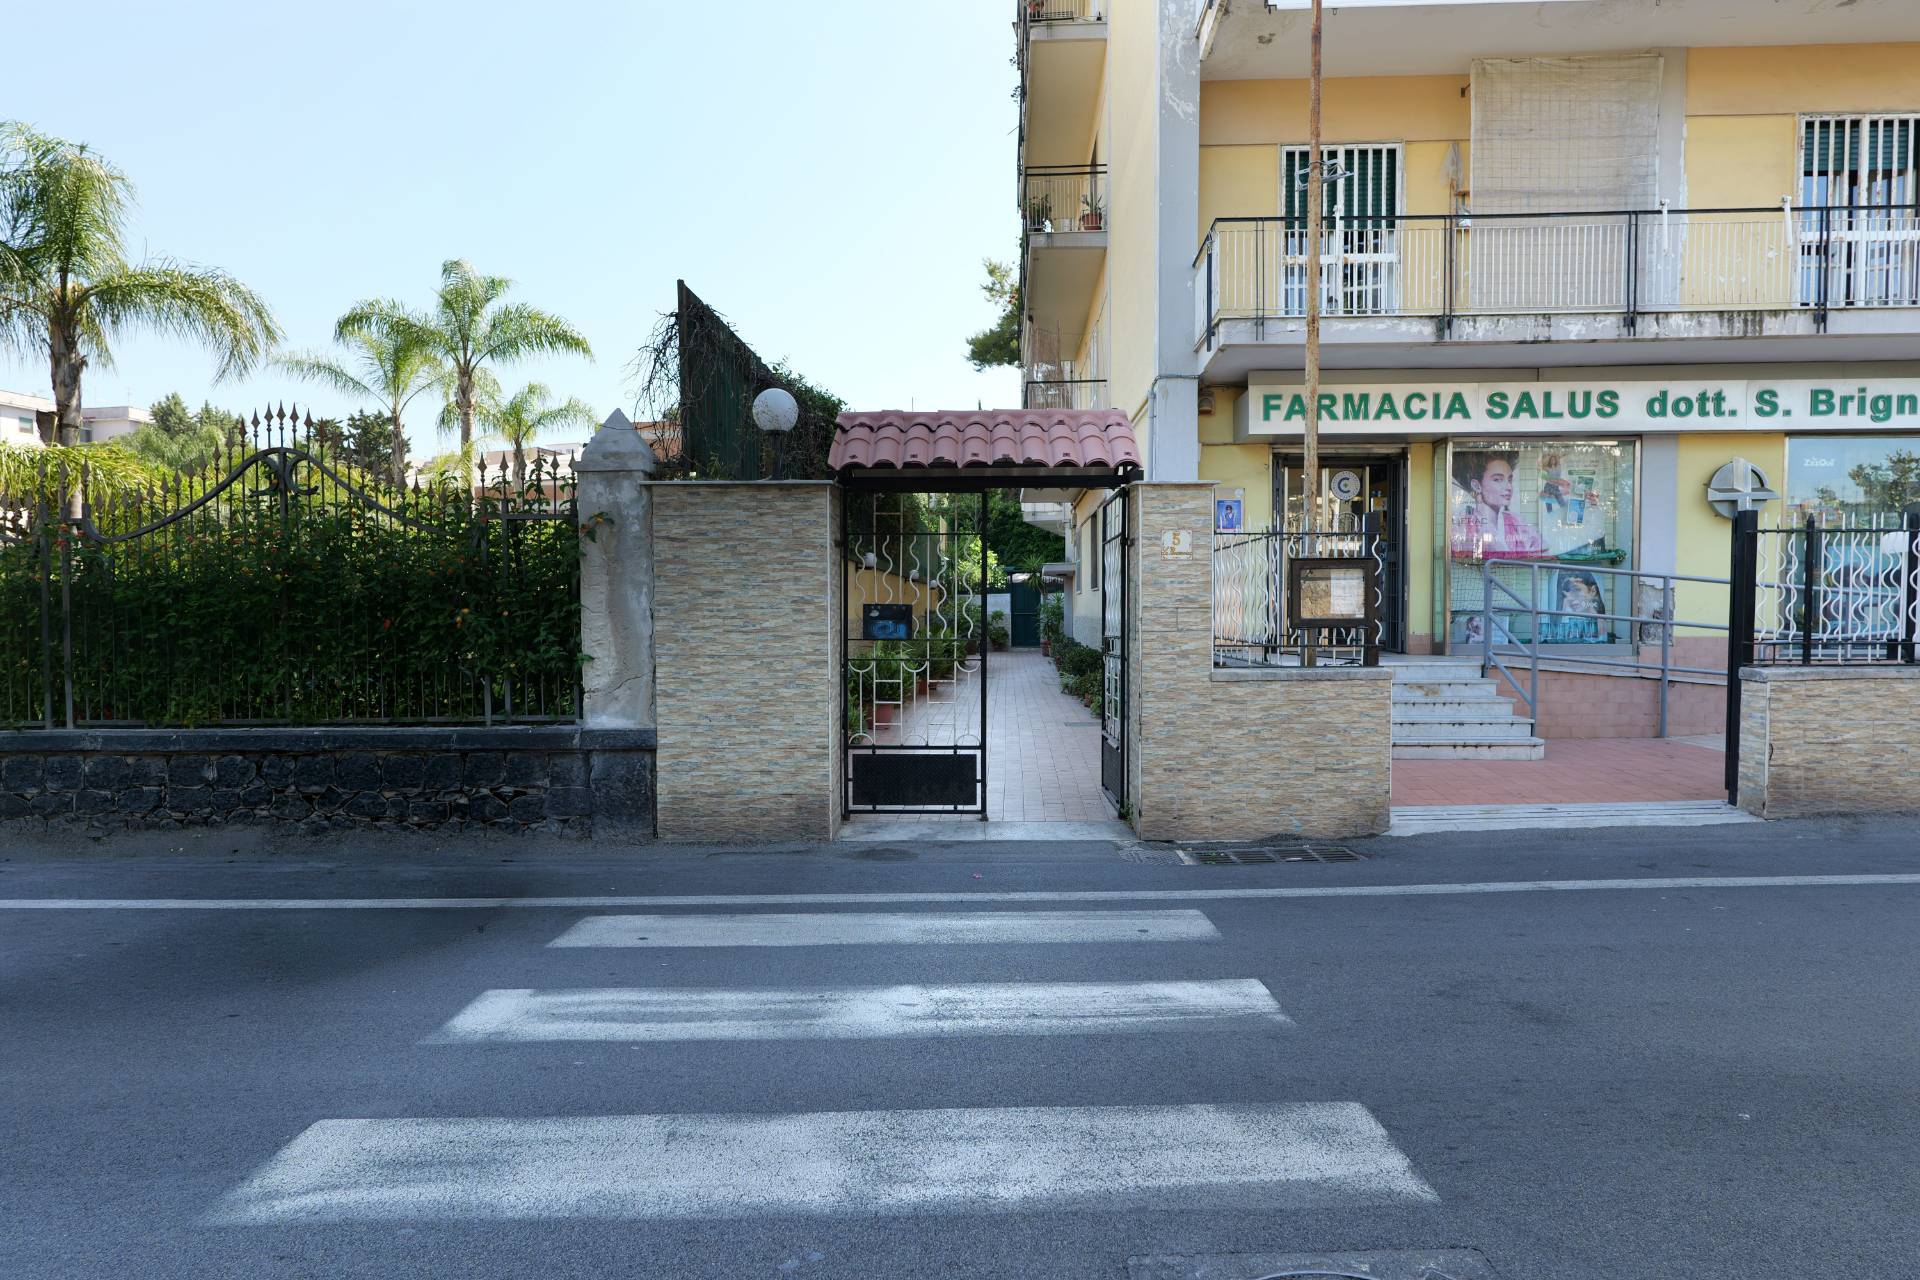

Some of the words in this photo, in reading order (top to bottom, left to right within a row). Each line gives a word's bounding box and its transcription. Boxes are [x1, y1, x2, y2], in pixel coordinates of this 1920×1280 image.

[1262, 392, 1472, 421] FARMACIA
[1485, 390, 1620, 419] SALUS
[1646, 389, 1738, 418] dott.
[1754, 389, 1792, 417] S.
[1810, 387, 1918, 423] Brign
[1172, 531, 1181, 546] 5
